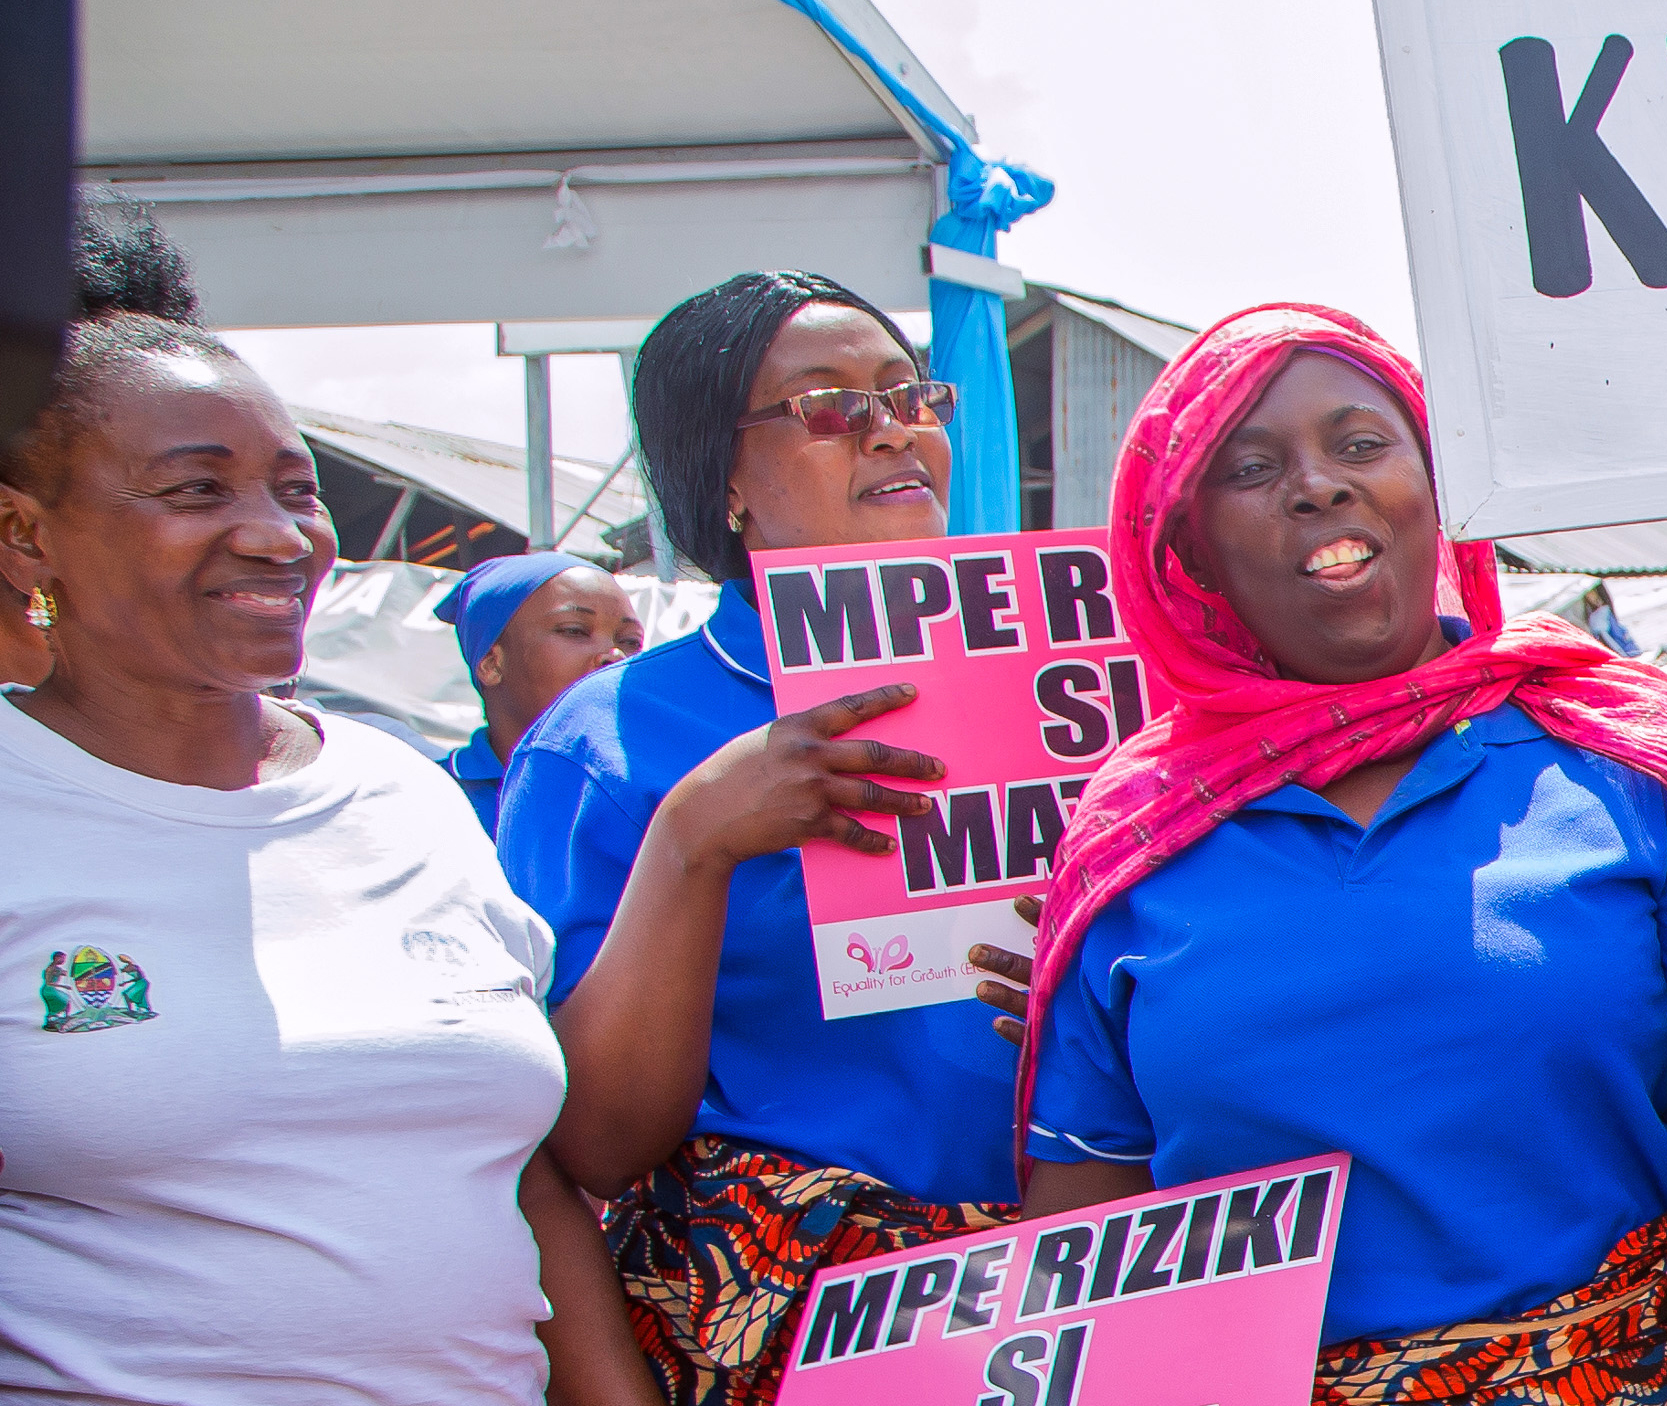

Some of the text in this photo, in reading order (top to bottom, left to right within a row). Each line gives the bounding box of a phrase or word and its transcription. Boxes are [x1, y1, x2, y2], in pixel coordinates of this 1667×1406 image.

[766, 549, 1027, 674] MPE
[1034, 655, 1151, 763] SI
[833, 976, 884, 997] Equality
[890, 974, 906, 987] for
[911, 966, 956, 982] Growth
[796, 1166, 1340, 1371] MPE RIZIKI
